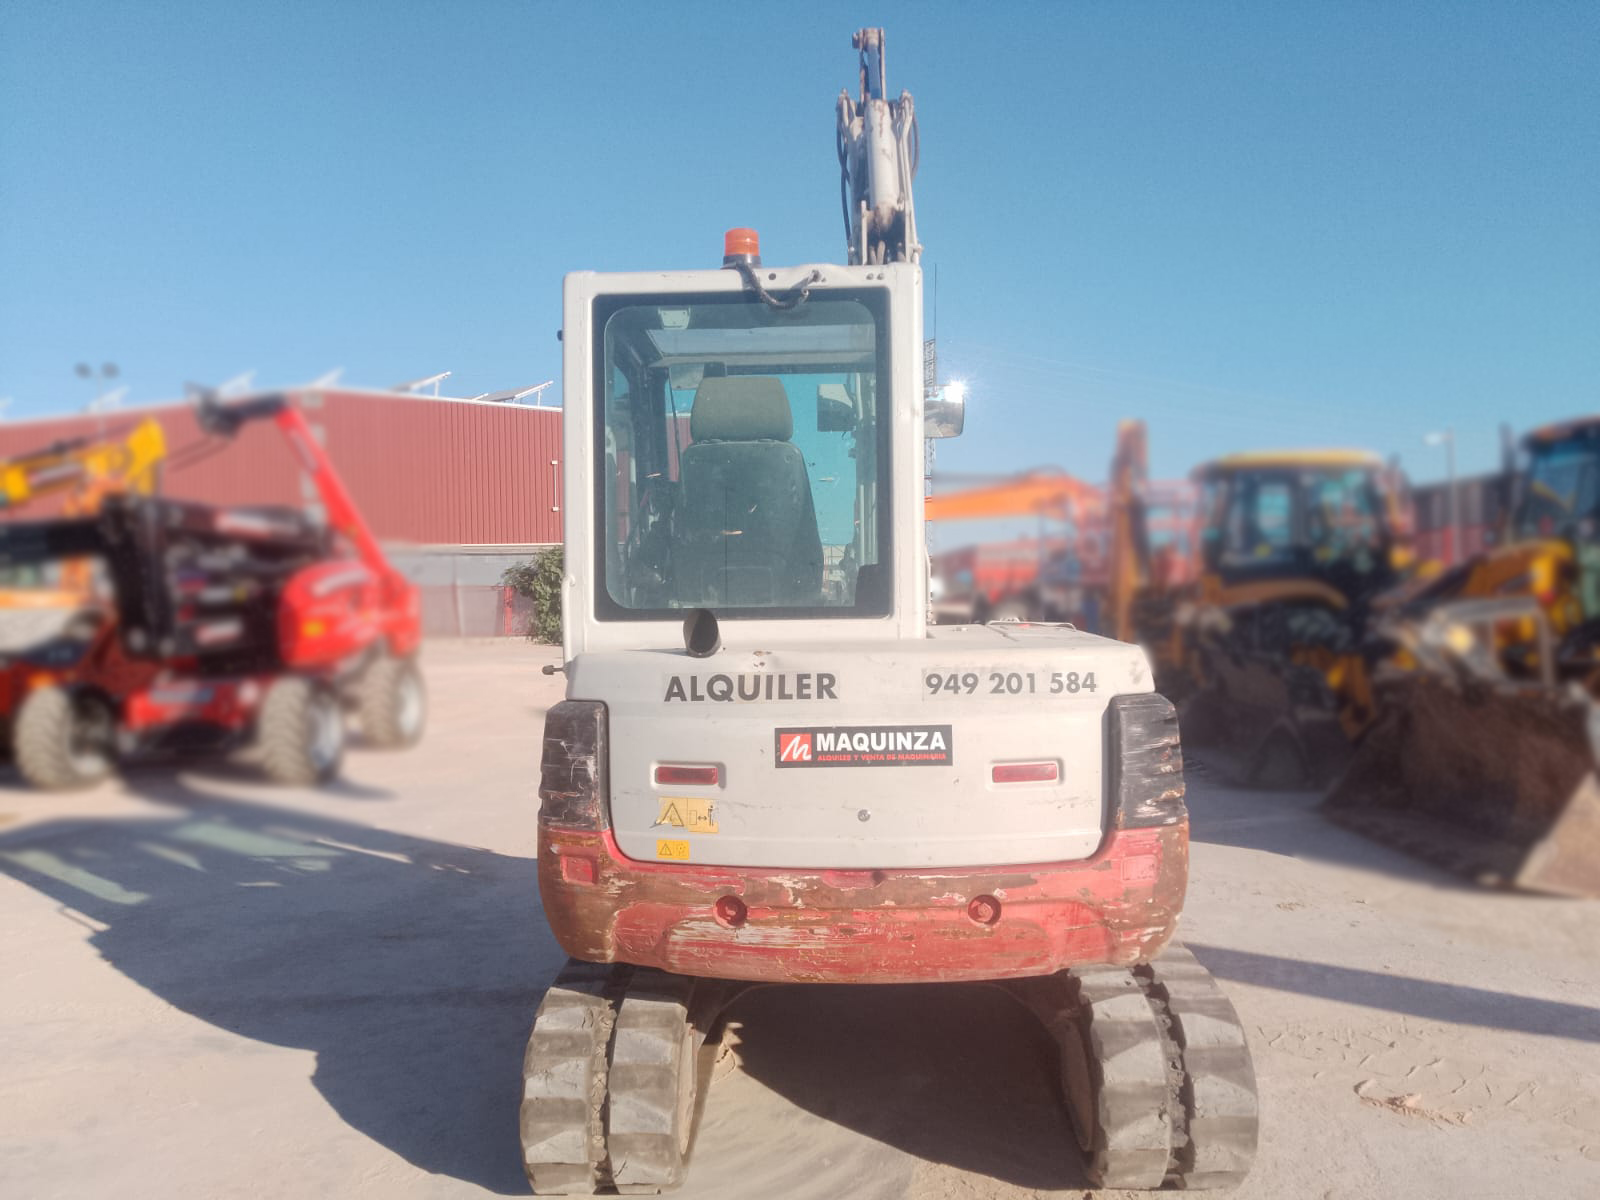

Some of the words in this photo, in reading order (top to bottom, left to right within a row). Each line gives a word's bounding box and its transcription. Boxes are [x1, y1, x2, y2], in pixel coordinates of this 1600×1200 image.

[663, 672, 838, 703] ALQUILER
[925, 672, 979, 695] 949
[989, 672, 1036, 694] 201
[1049, 671, 1097, 694] 584
[816, 731, 947, 753] MAQUINZA
